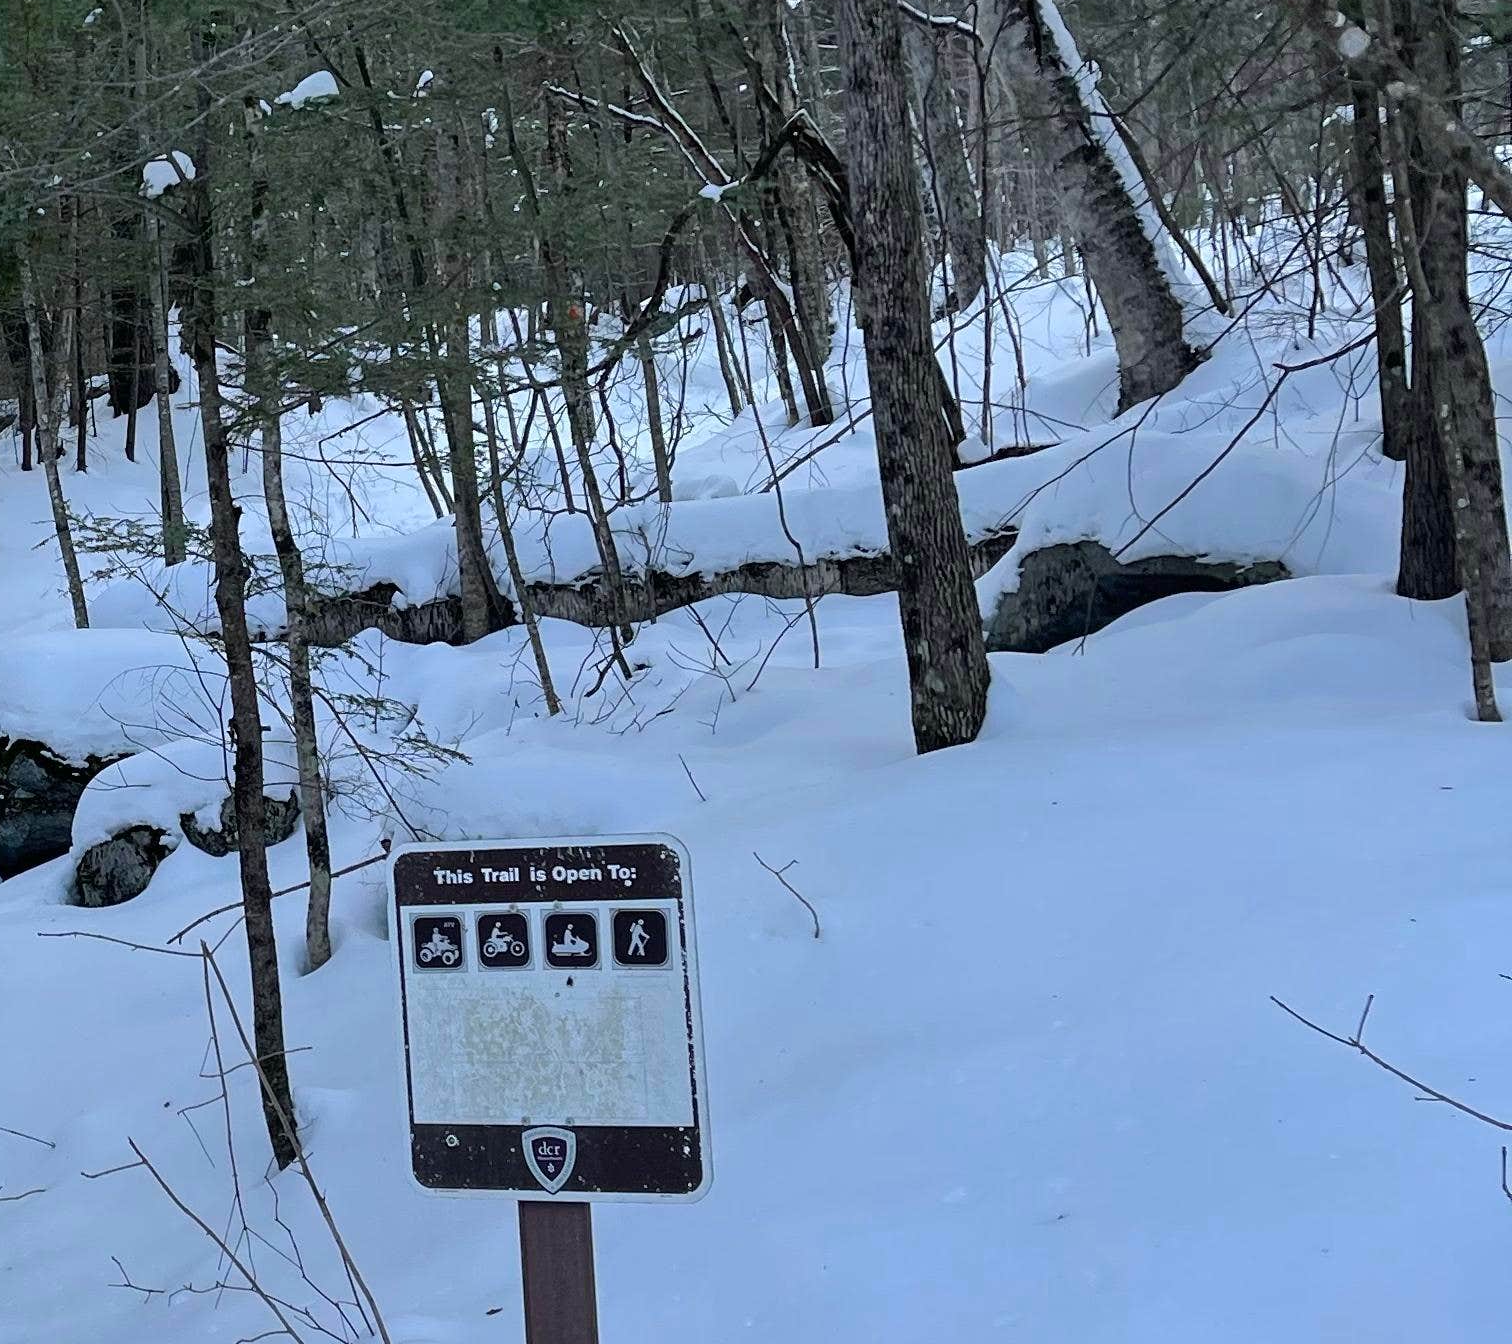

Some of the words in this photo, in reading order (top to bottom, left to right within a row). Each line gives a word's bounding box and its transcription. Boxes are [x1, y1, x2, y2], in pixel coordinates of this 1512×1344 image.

[433, 867, 474, 885] This
[481, 867, 520, 883] Trail
[529, 866, 547, 882] is
[552, 865, 602, 884] Open
[607, 864, 637, 880] To:
[538, 1141, 561, 1156] dcr
